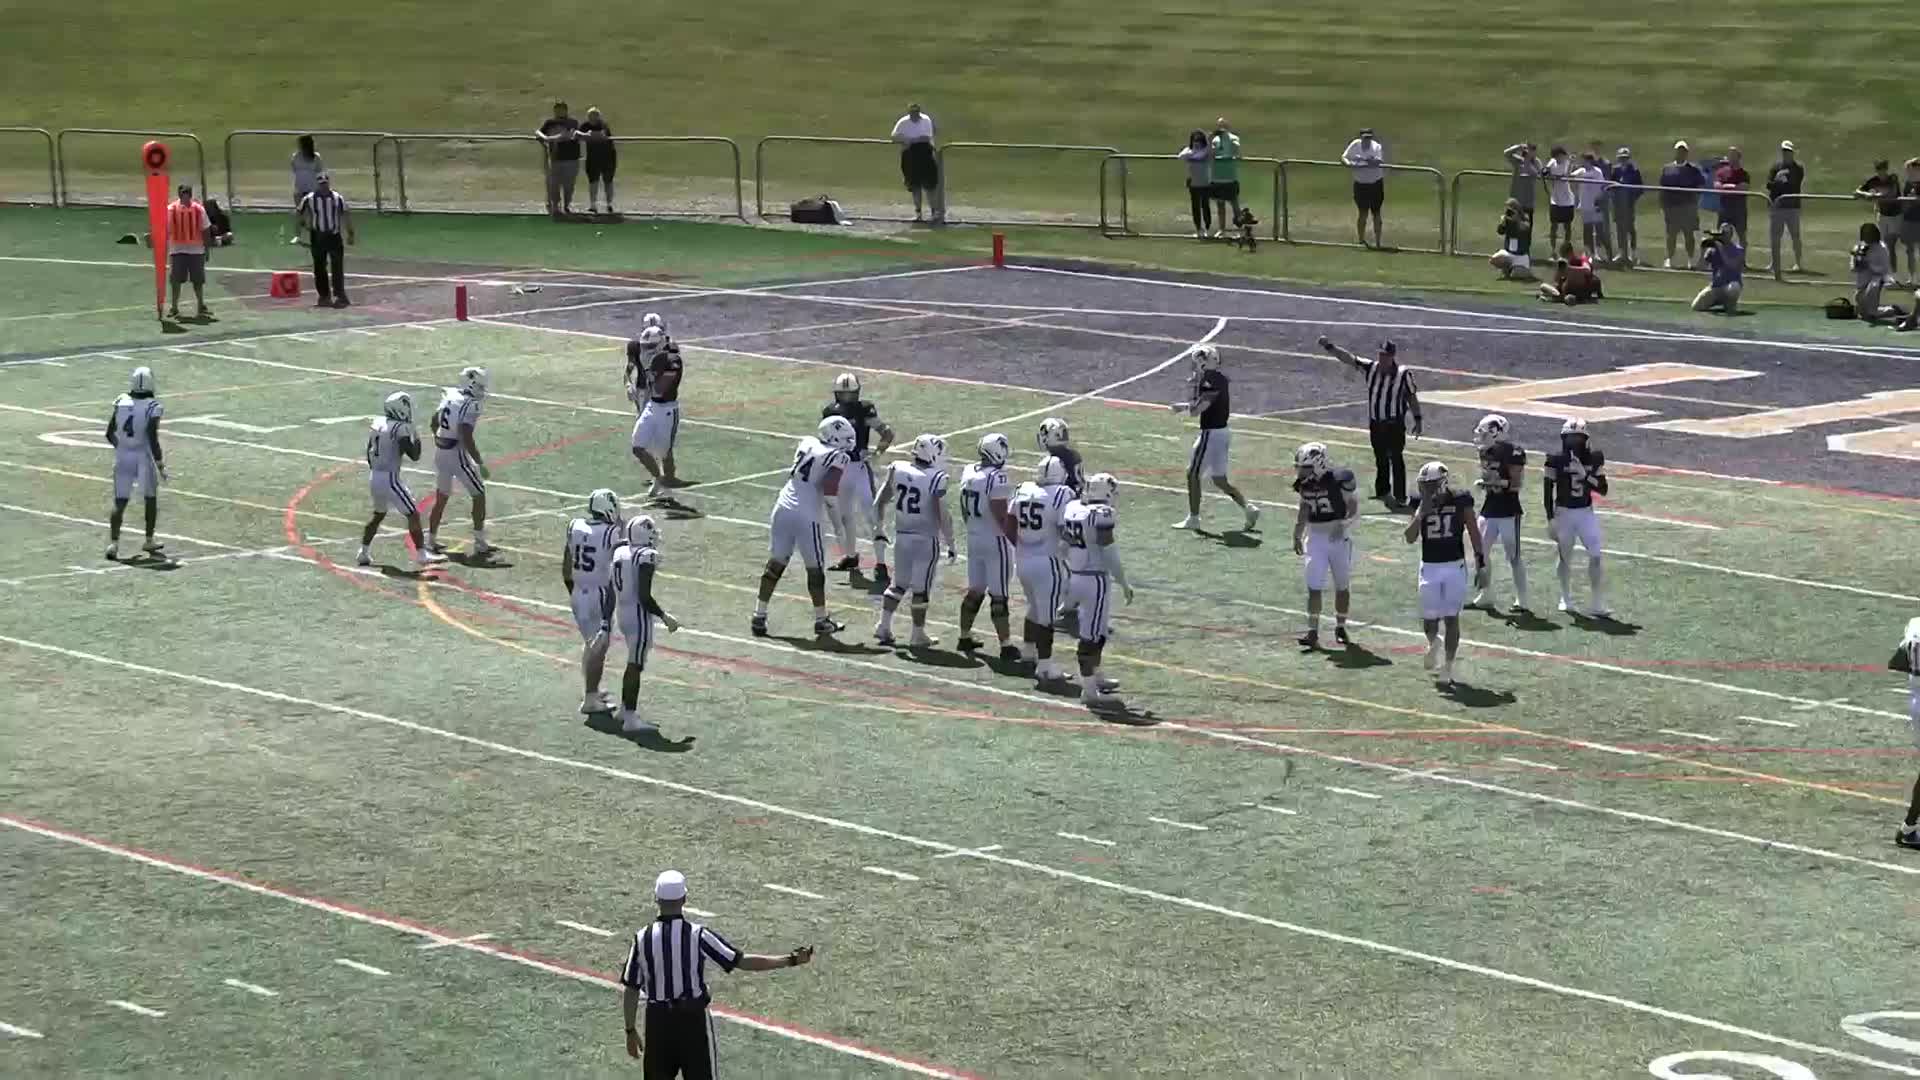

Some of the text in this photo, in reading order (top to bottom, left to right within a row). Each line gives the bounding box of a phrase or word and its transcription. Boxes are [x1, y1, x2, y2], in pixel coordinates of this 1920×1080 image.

[123, 414, 137, 438] 4
[896, 493, 922, 515] 72
[1019, 502, 1045, 531] 55
[1426, 514, 1455, 540] 21
[573, 543, 597, 572] 15
